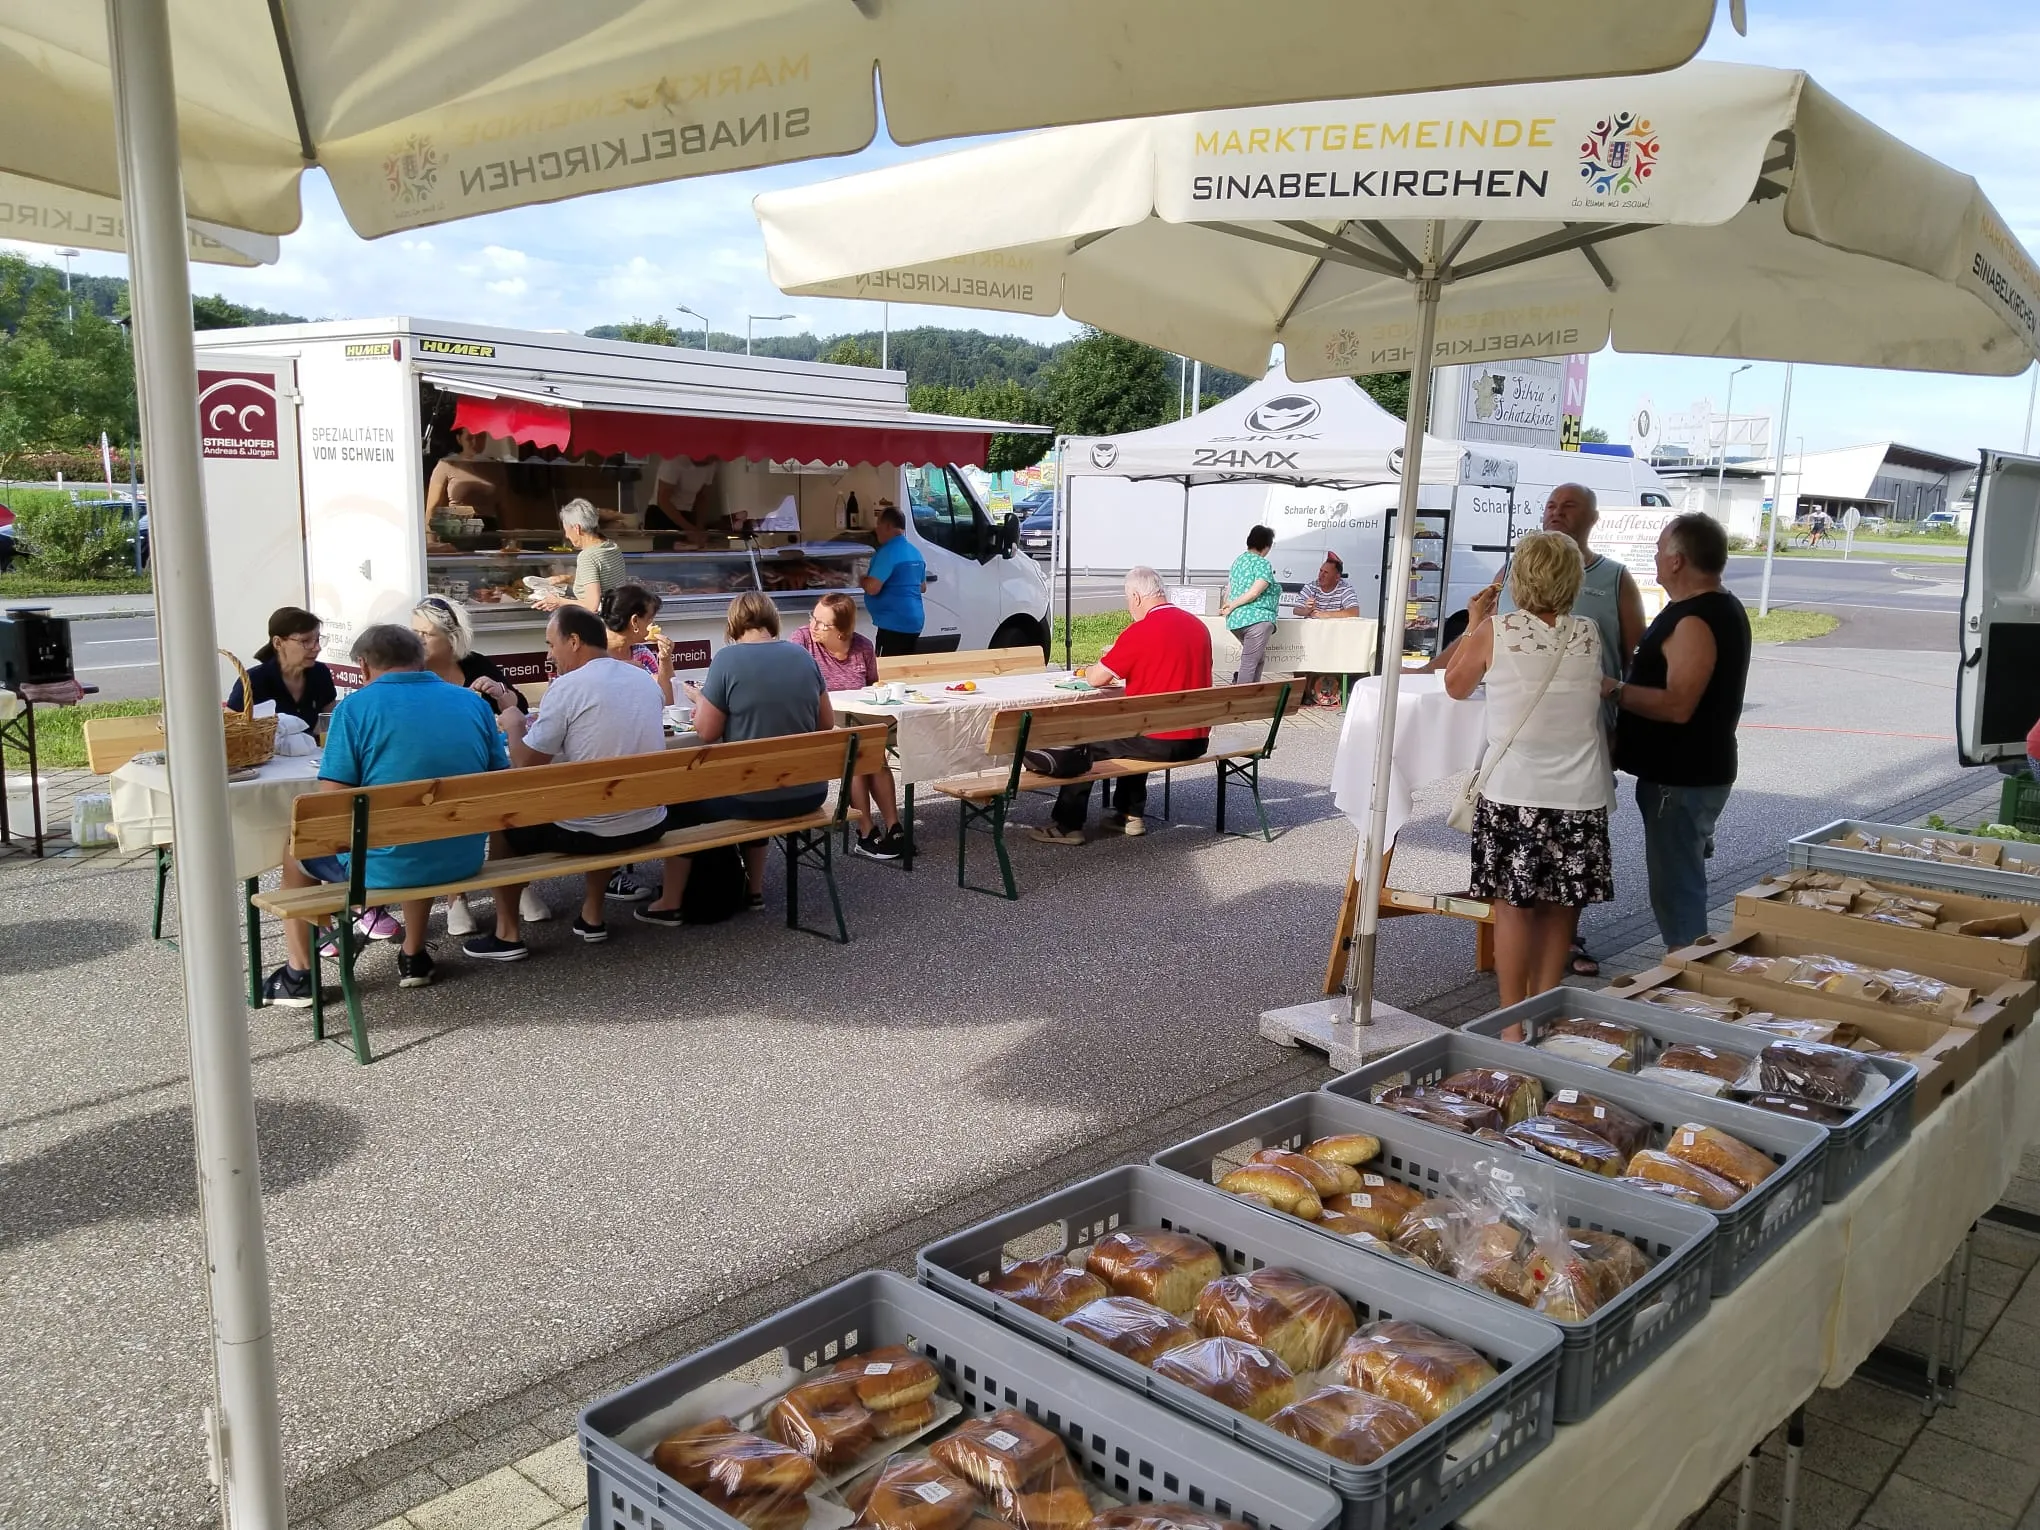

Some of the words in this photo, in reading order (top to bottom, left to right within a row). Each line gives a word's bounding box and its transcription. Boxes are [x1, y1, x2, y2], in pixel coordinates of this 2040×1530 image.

[1194, 118, 1556, 156] MARKTGEMEINDE
[1193, 169, 1549, 200] SINABELKIRCHEN
[1972, 252, 2037, 335] SINABELKIRCHEN
[347, 345, 390, 356] HUMER
[423, 340, 493, 357] HUMER
[1493, 397, 1555, 426] Schatzkiste
[203, 437, 275, 449] STREILHOFER
[204, 446, 238, 455] Andreas
[239, 447, 246, 455] &
[247, 448, 275, 457] Jürgen
[313, 446, 337, 461] VOM
[341, 447, 395, 463] SCHWEIN
[1193, 448, 1299, 470] 24MX
[1319, 505, 1325, 515] &
[1523, 500, 1532, 515] &
[1307, 518, 1346, 530] Berghold
[1349, 519, 1379, 529] GmbH
[544, 660, 553, 673] 5
